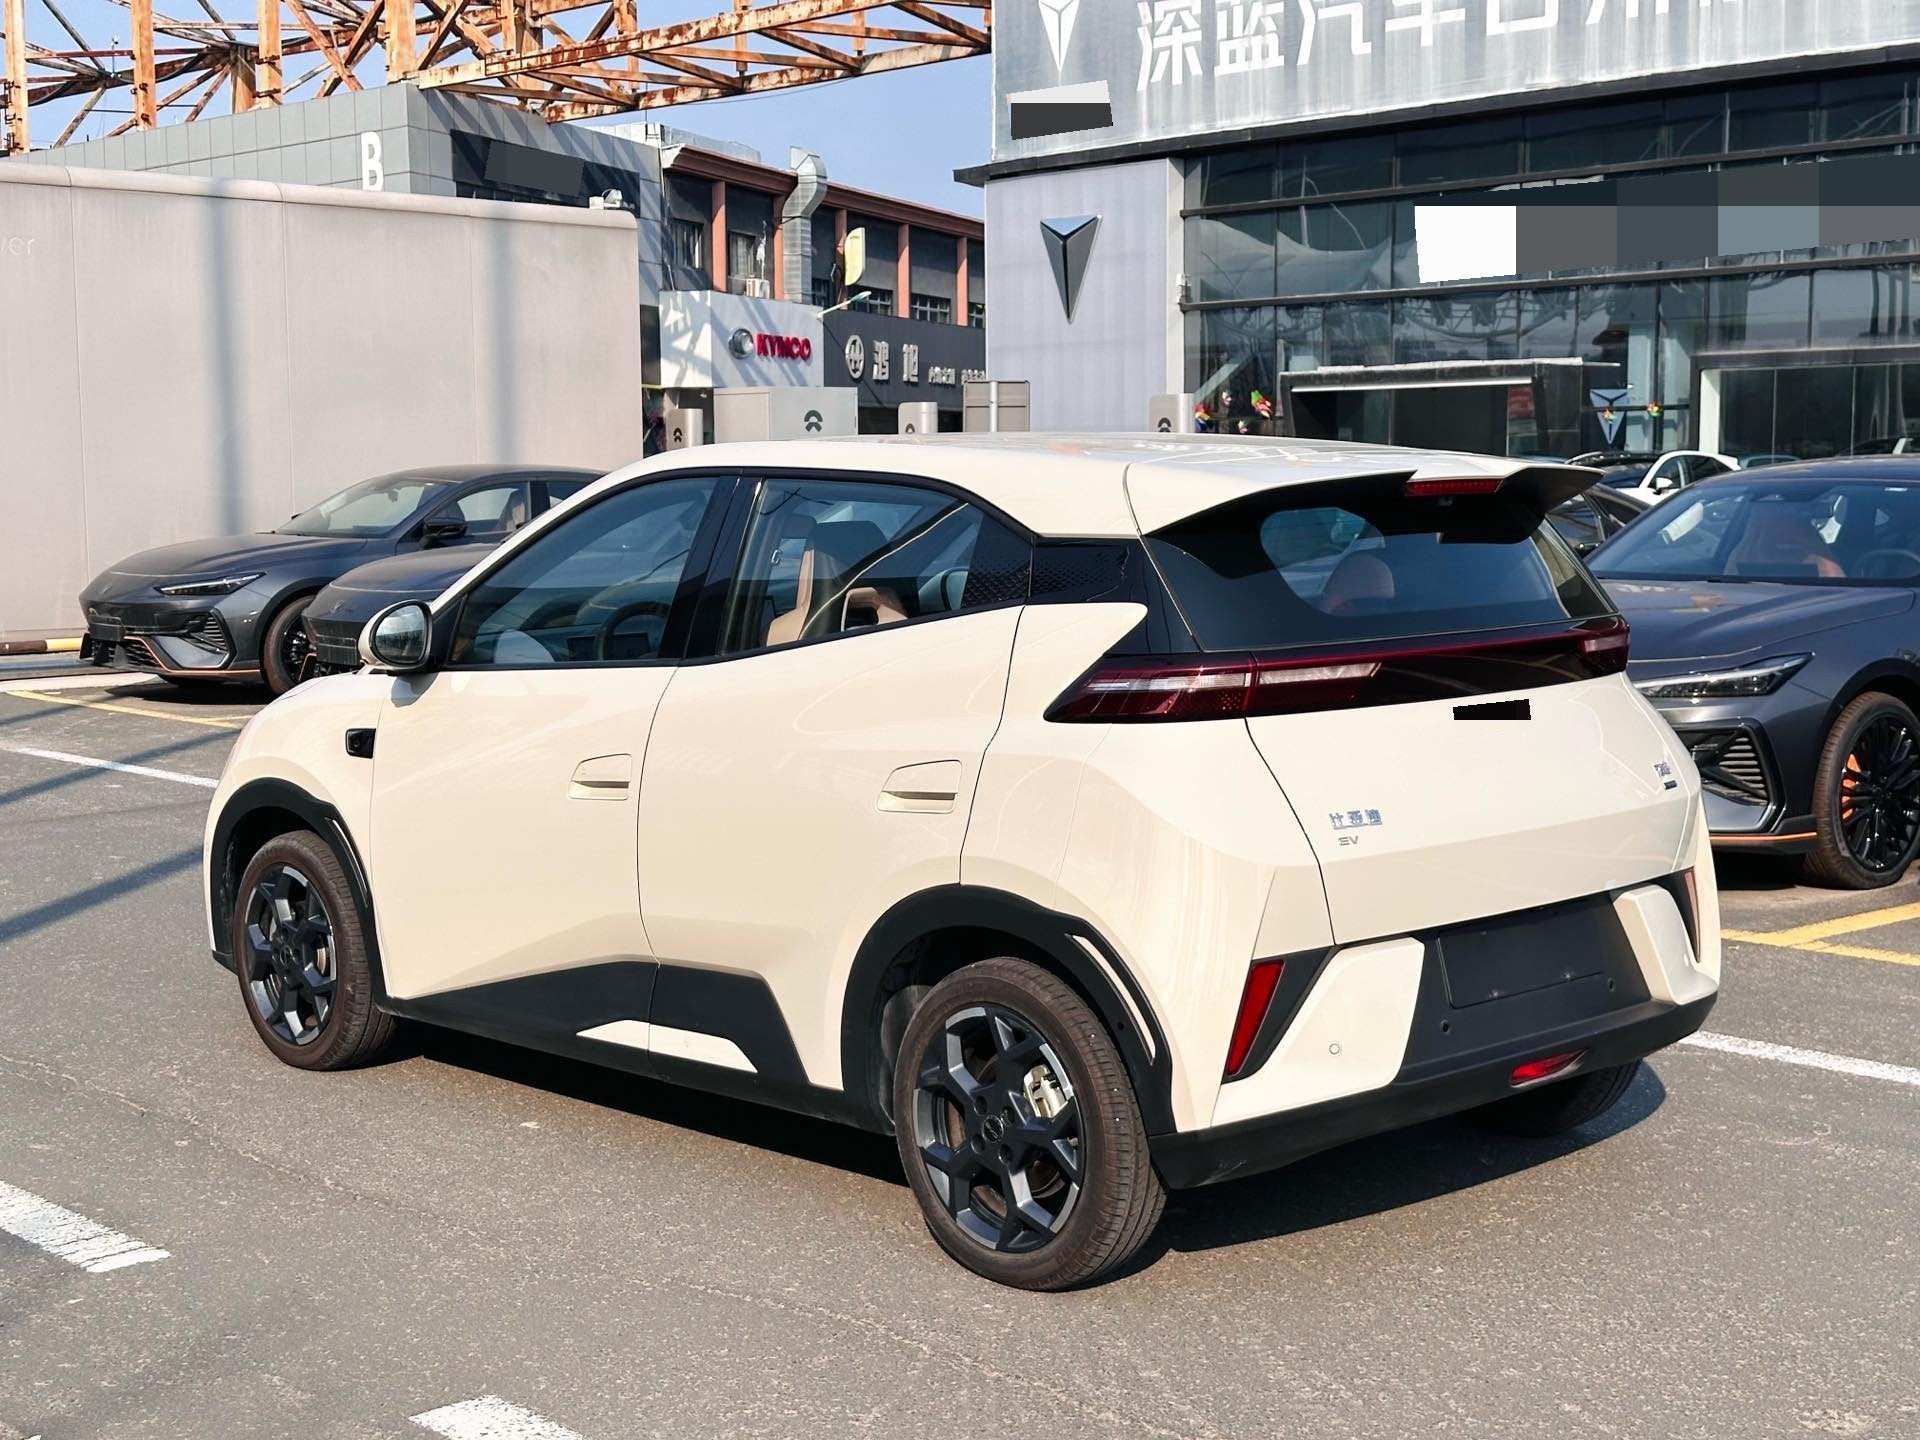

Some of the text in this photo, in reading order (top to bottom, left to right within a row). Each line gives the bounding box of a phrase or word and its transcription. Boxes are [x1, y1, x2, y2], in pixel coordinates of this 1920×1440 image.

[361, 131, 384, 191] B
[0, 237, 35, 256] er
[756, 333, 812, 361] KYMCO
[1338, 836, 1359, 846] EV
